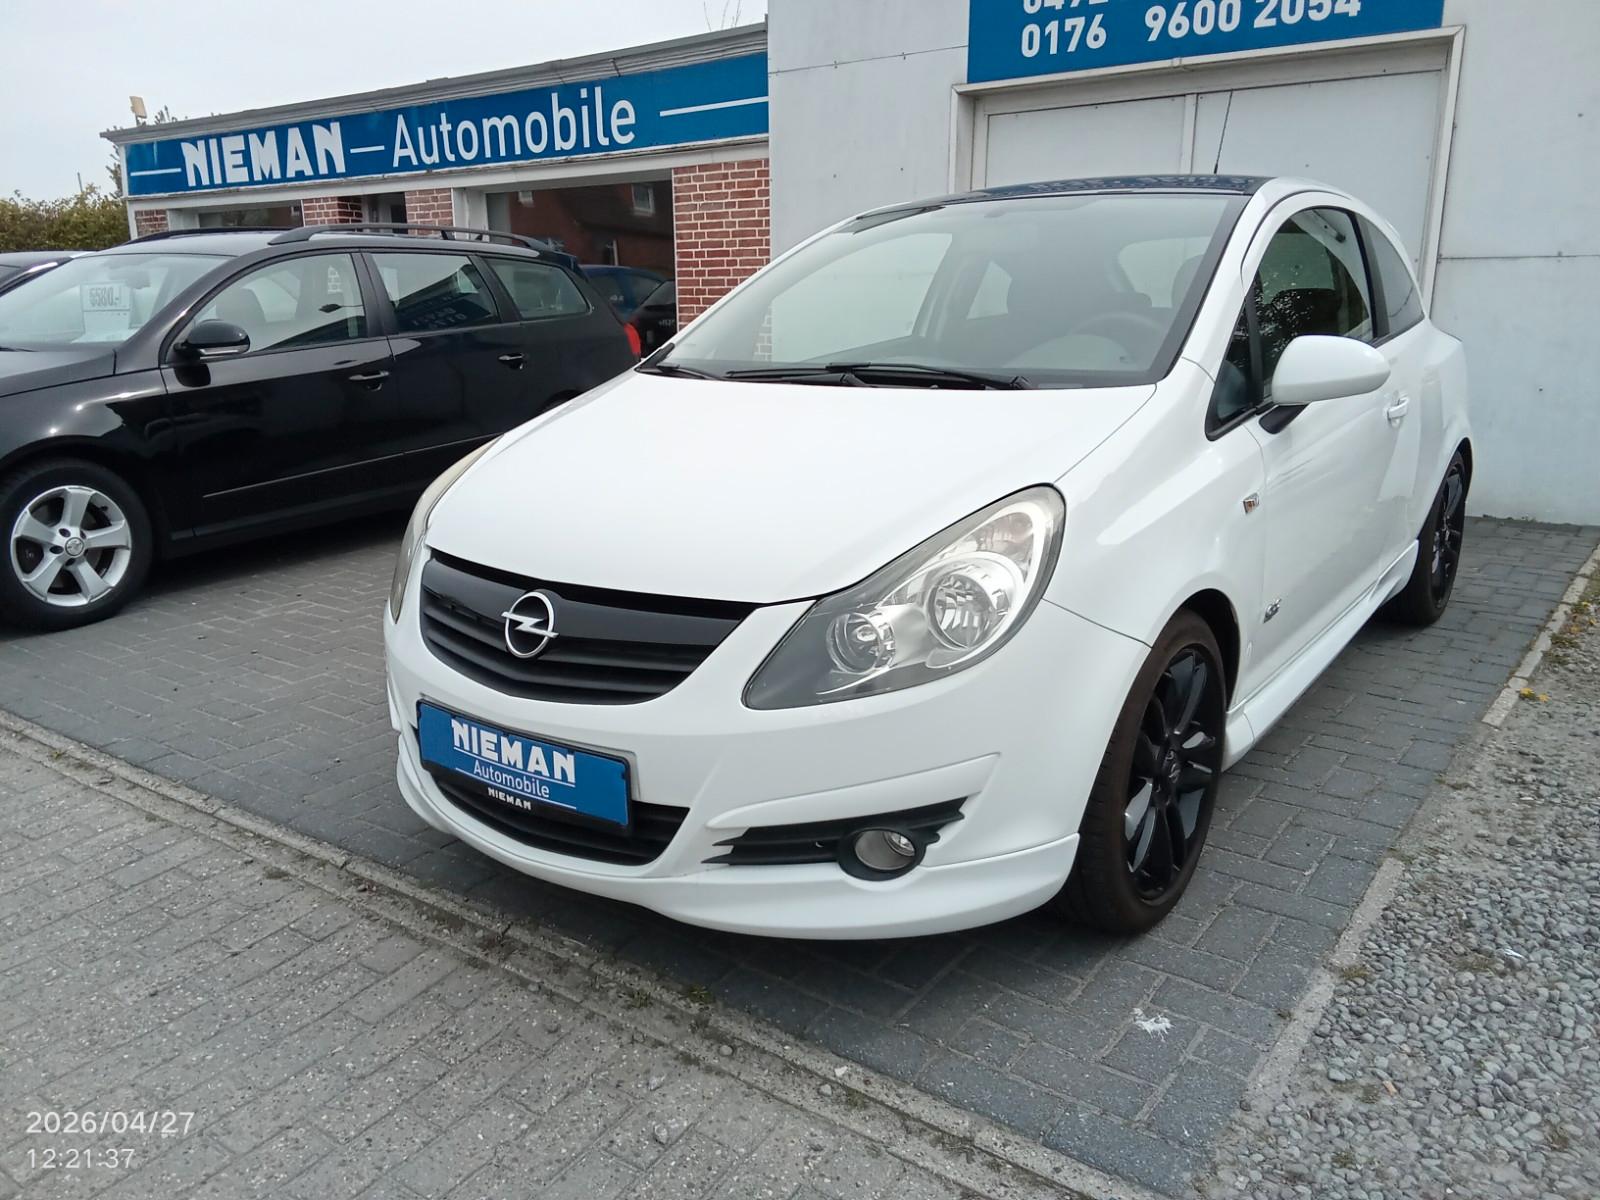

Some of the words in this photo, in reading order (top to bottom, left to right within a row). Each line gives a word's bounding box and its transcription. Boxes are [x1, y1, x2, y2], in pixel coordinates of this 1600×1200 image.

[1021, 13, 1107, 58] 0176
[1145, 0, 1241, 42] 9600
[179, 121, 345, 187] NIEMAN
[393, 86, 636, 168] Automobile
[451, 718, 576, 783] NIEMAN
[473, 760, 550, 798] Automobile
[488, 787, 531, 811] NIEMAN
